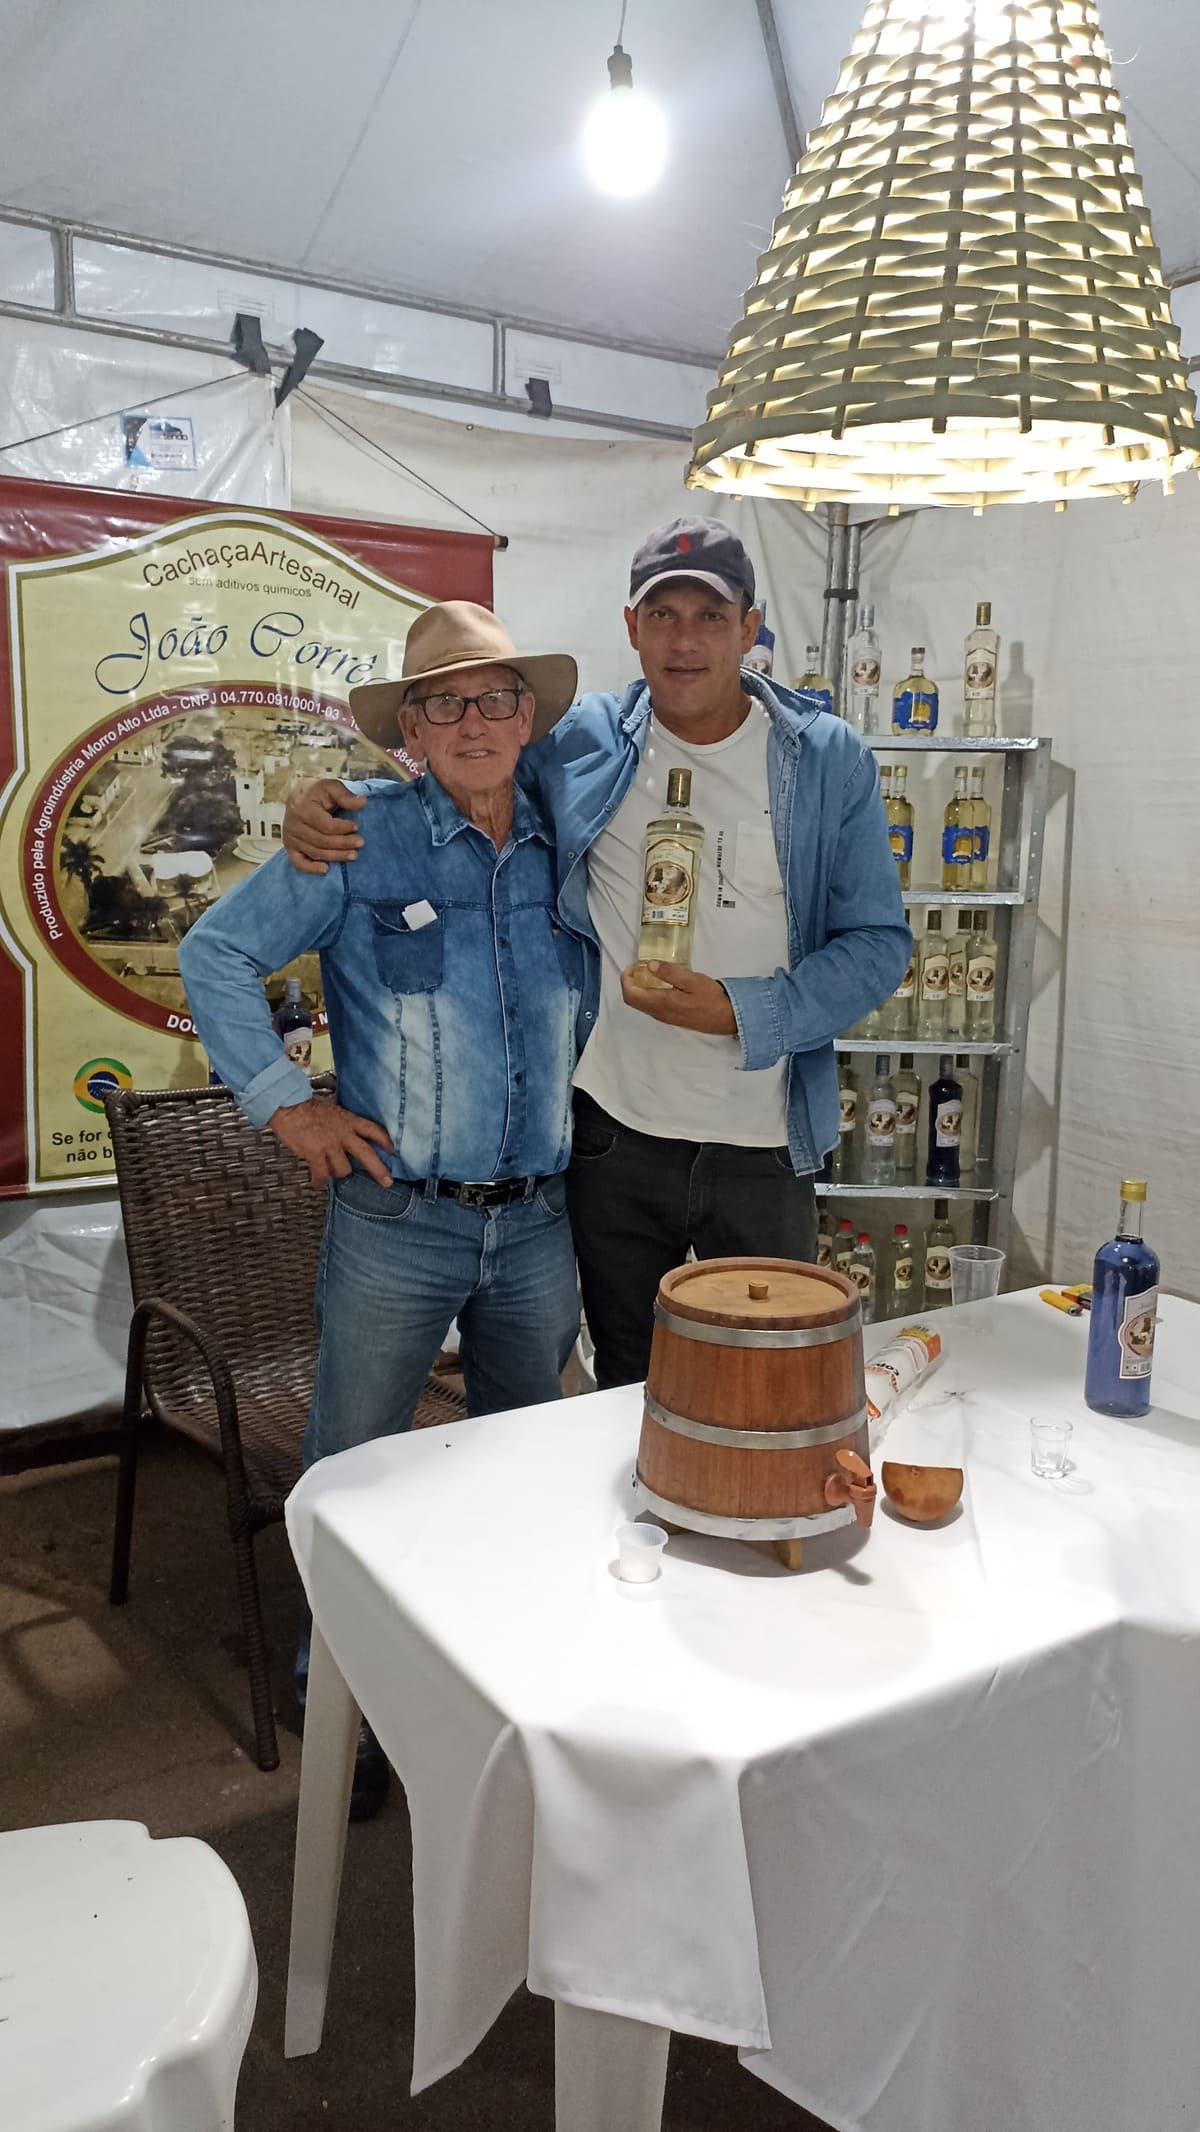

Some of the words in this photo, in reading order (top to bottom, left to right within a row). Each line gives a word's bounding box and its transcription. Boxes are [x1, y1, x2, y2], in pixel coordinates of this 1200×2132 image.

[188, 575, 213, 587] sem
[216, 578, 260, 592] aditivos
[95, 612, 228, 695] João
[250, 611, 390, 687] Corrê
[143, 705, 170, 723] Ltda
[180, 690, 217, 710] CNPJ
[221, 691, 340, 720] 04.770.091/0001-03
[117, 717, 141, 738] Alto
[81, 730, 116, 760] Morro
[393, 748, 425, 776] 3846-
[34, 757, 85, 838] Agroindústria
[31, 840, 47, 870] pela
[32, 872, 63, 940] Produzido
[52, 1132, 74, 1146] Se
[79, 1130, 102, 1143] for
[66, 1149, 97, 1163] não
